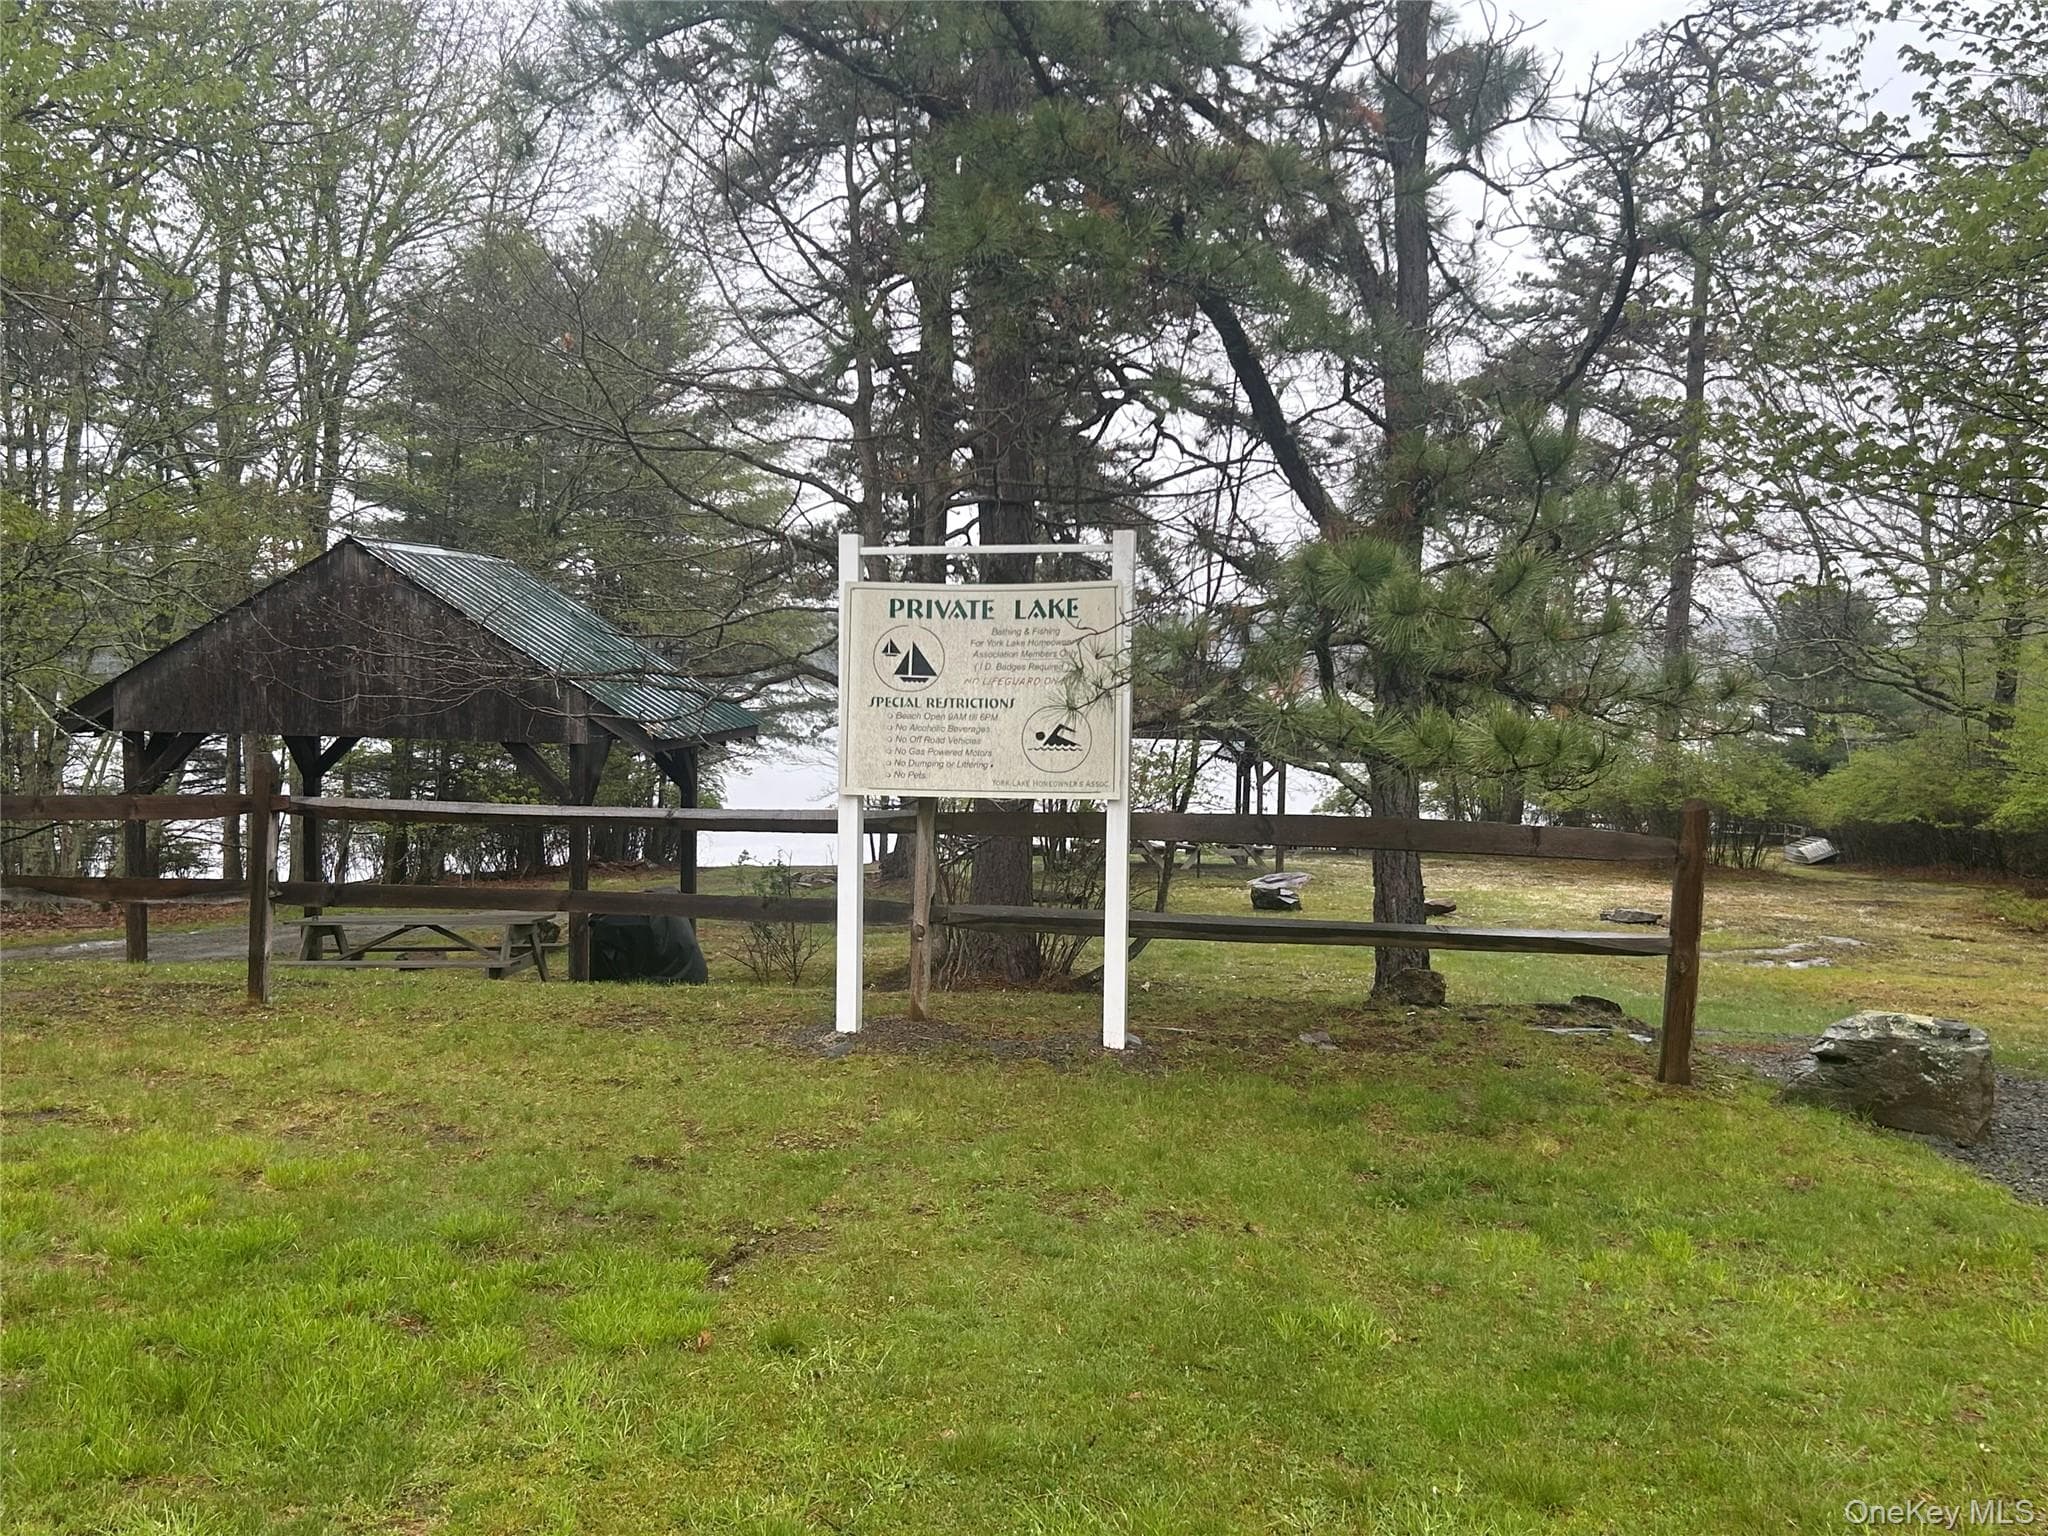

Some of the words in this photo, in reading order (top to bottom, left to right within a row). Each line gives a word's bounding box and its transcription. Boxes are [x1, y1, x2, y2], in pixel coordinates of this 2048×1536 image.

[889, 598, 994, 620] PRIVATE
[1014, 598, 1080, 620] LAKE
[991, 627, 1022, 637] Bathing
[1024, 627, 1030, 635] &
[1032, 627, 1061, 637] Fishing
[970, 639, 985, 647] For
[987, 639, 1004, 647] York
[1007, 639, 1026, 647] Lake
[972, 650, 1019, 658] Association
[1020, 650, 1058, 658] Members
[995, 662, 1026, 672] Badges
[982, 677, 1041, 686] LIFEGUARD
[869, 696, 921, 708] SPECIAL
[926, 697, 1016, 709] RESTRICTIONS
[895, 712, 922, 720] Beach
[924, 712, 946, 722] Open
[979, 713, 999, 721] 6PM
[895, 724, 908, 732] No
[909, 724, 946, 733] Alcoholic
[947, 725, 990, 735] Beverages
[909, 736, 922, 744] Off
[924, 736, 946, 744] Road
[948, 736, 982, 745] Vehicles
[894, 748, 907, 756] No
[908, 748, 926, 756] Gas
[927, 748, 962, 757] Powered
[964, 749, 993, 757] Motors
[894, 759, 907, 767] No
[908, 759, 944, 769] Dumping
[956, 760, 989, 771] Littering
[893, 771, 906, 779] No
